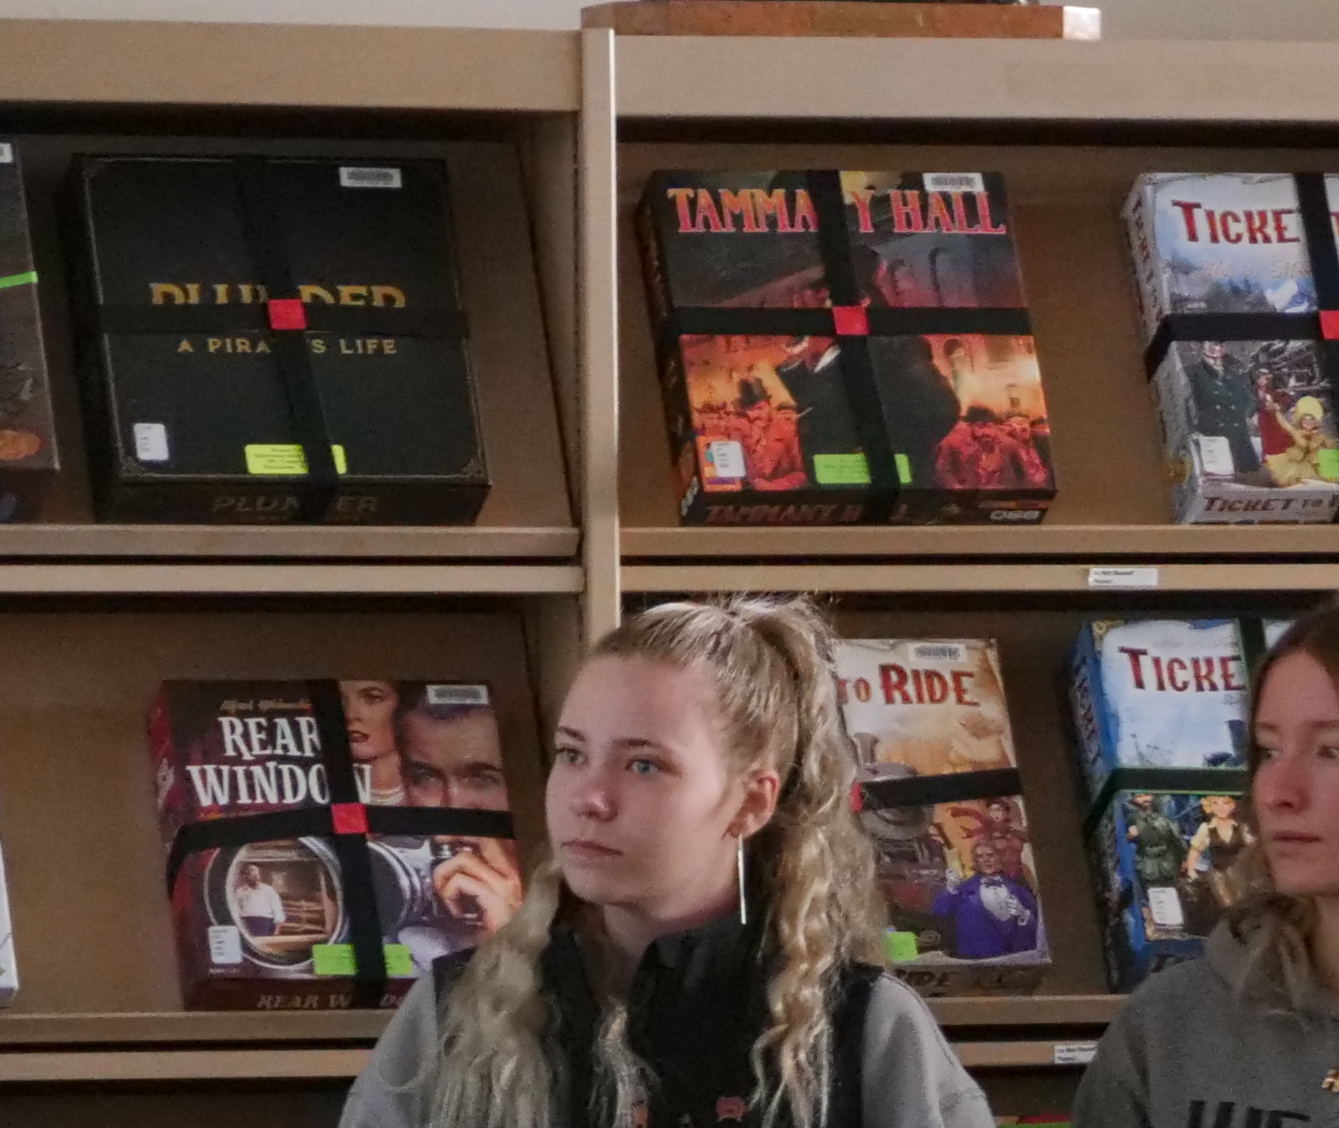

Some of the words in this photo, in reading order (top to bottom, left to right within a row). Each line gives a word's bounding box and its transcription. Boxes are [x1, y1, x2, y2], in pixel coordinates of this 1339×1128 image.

[666, 188, 876, 233] TAMMAY
[889, 189, 1007, 235] HALL
[1171, 199, 1301, 245] TICKE
[177, 338, 194, 353] A
[207, 337, 327, 354] PIRAS
[340, 338, 398, 355] LIFE
[879, 663, 980, 707] RIDE
[1118, 646, 1246, 693] TICKE
